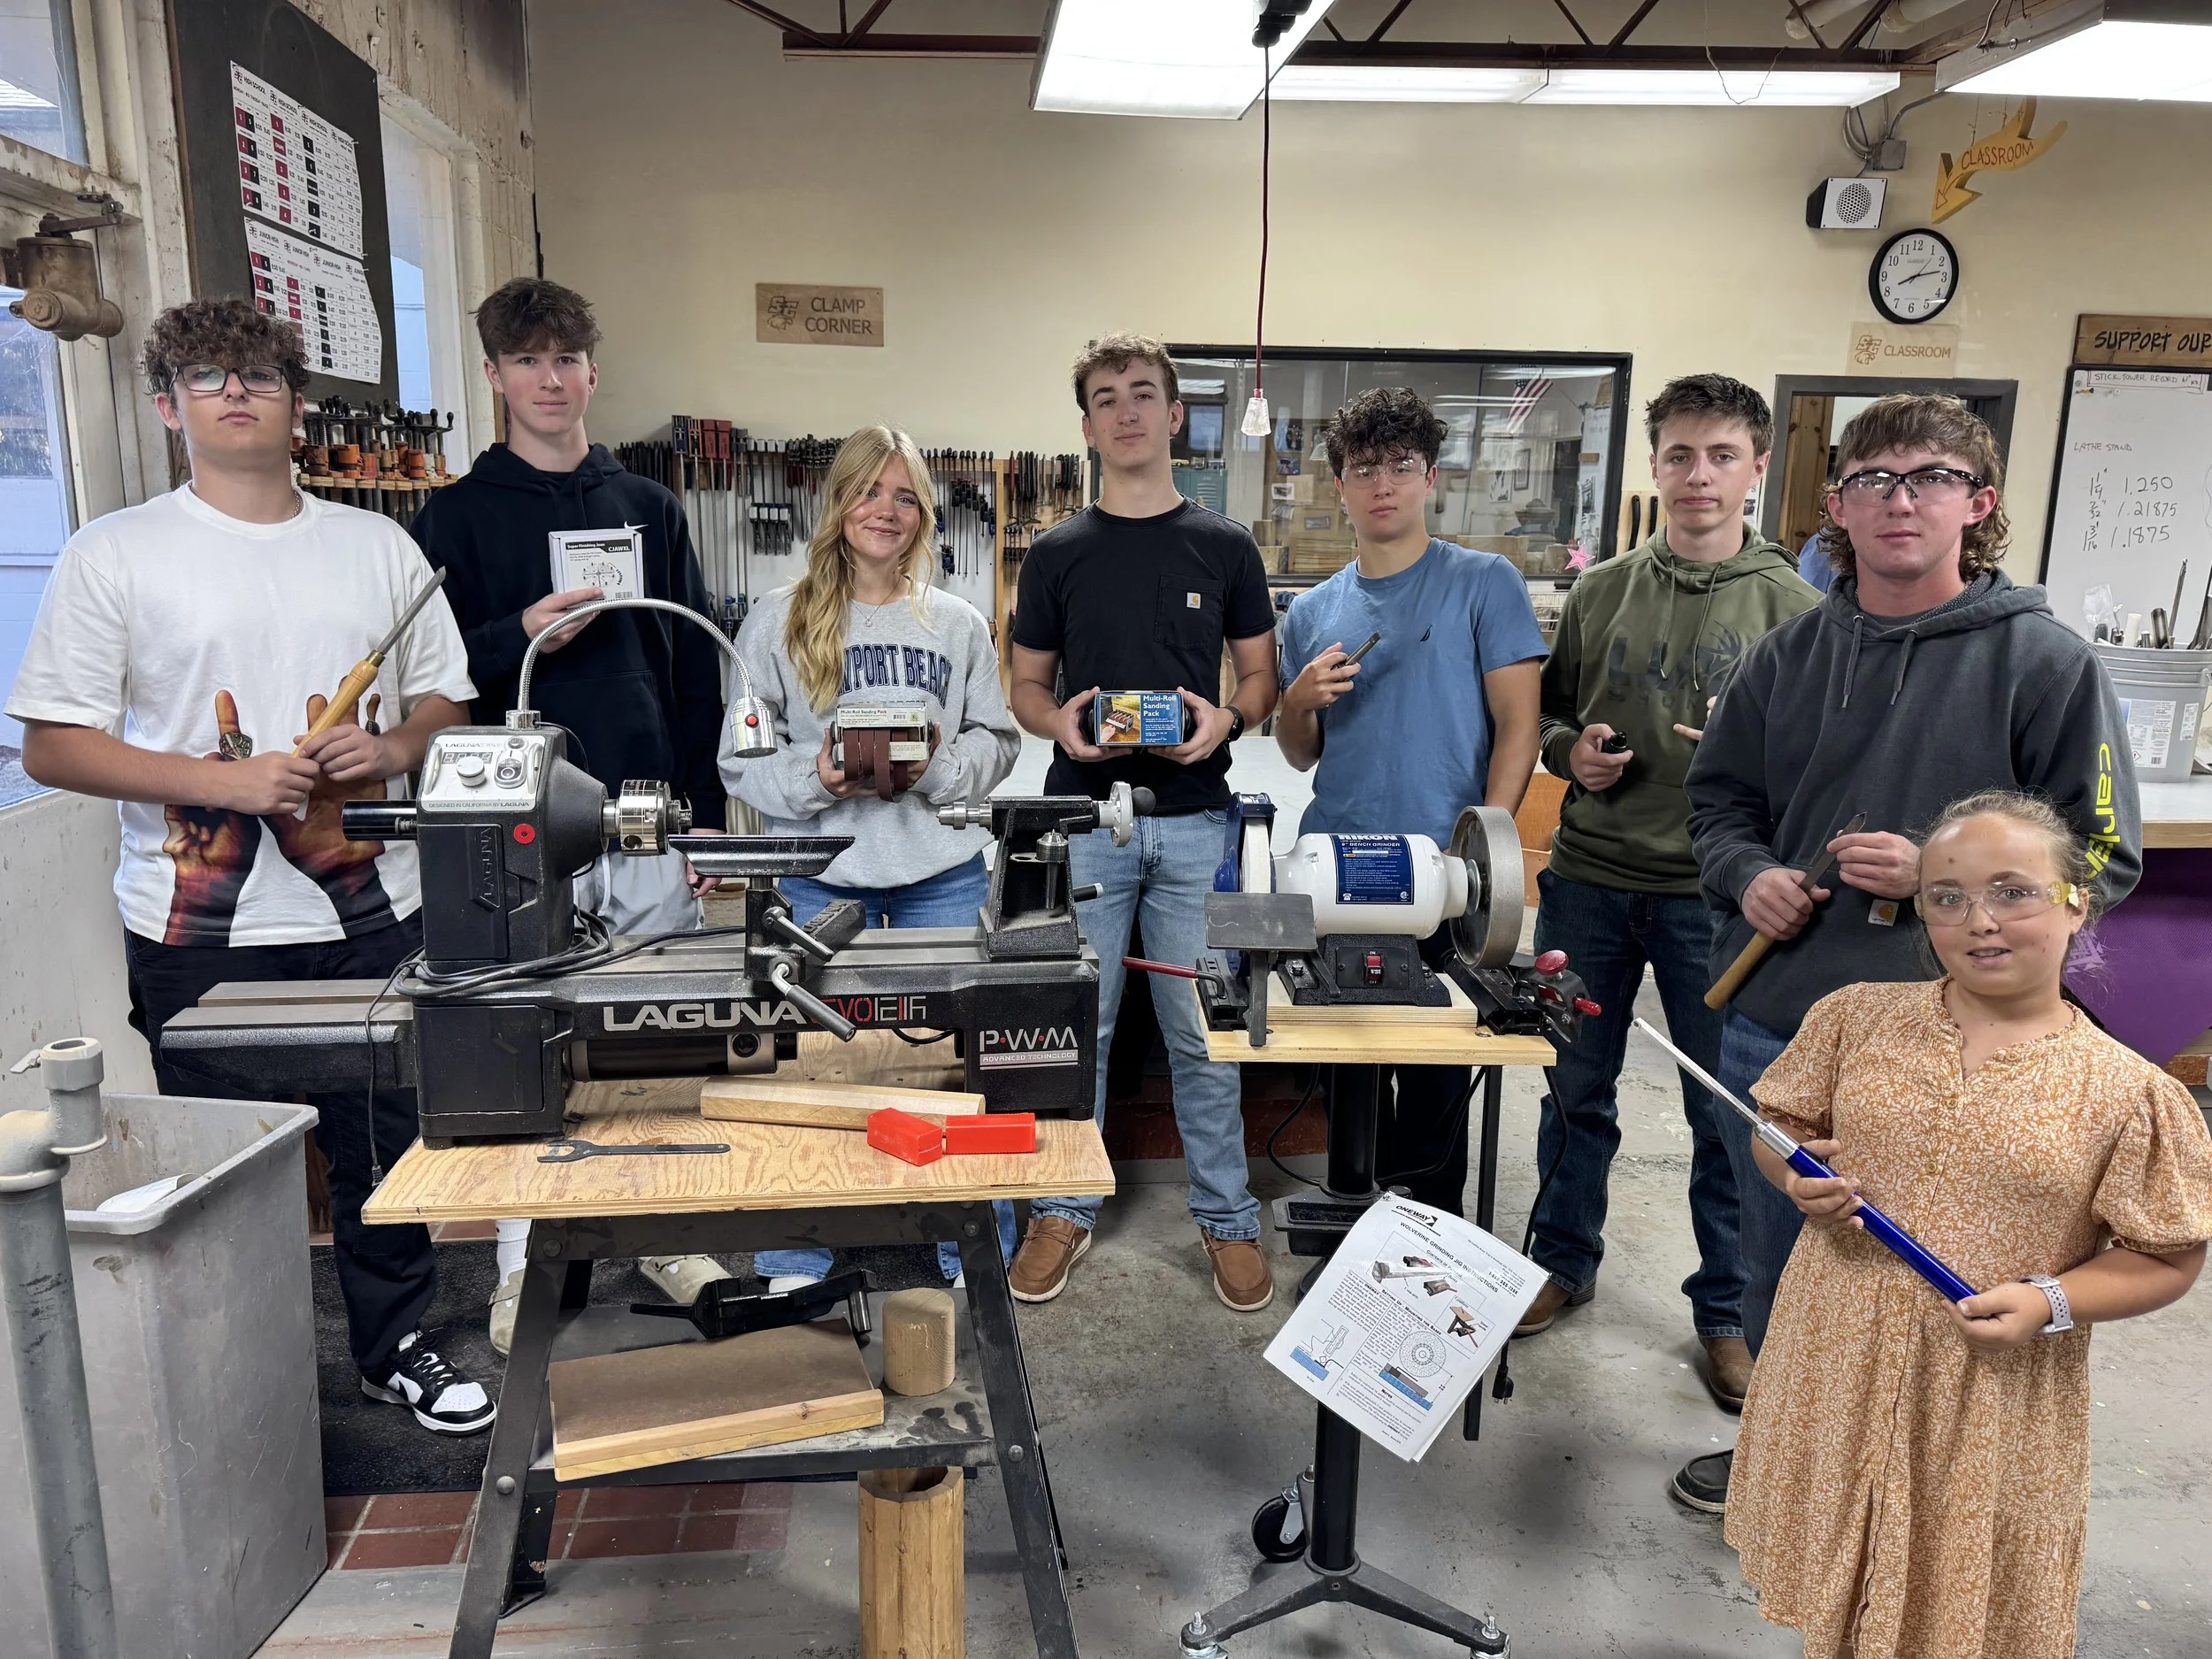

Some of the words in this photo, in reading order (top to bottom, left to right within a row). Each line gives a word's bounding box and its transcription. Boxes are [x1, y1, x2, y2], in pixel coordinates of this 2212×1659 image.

[1961, 141, 2034, 170] CLASSROOM
[1900, 244, 1909, 255] 11
[1913, 240, 1924, 250] 12
[1931, 245, 1935, 255] 1
[1889, 255, 1899, 266] 10
[1939, 256, 1945, 267] 2
[1881, 271, 1888, 282] 9
[1941, 271, 1947, 283] 3
[1884, 286, 1890, 297] 8
[1935, 288, 1941, 298] 4
[810, 296, 865, 314] CLAMP
[1893, 298, 1900, 309] 7
[1908, 302, 1915, 313] 6
[1924, 299, 1929, 309] 5
[805, 317, 872, 334] CORNER
[2094, 330, 2172, 352] SUPPORT
[2177, 332, 2212, 353] OUR
[1884, 345, 1951, 358] CLASSROOM
[2150, 375, 2177, 383] RECORD
[2074, 442, 2102, 452] LATHE
[2106, 443, 2132, 452] STAND
[2125, 476, 2173, 495] 1.250
[2118, 501, 2177, 517] 1.21875
[2111, 525, 2170, 548] 1.1875
[603, 1000, 808, 1032] LAGUNA
[1396, 1205, 1432, 1221] ONEWAY
[1400, 1222, 1430, 1243] WOLVERINE
[1430, 1241, 1454, 1260] GRINDING
[1454, 1257, 1463, 1267] JIG
[1463, 1265, 1499, 1292] INSTRUCTIONS
